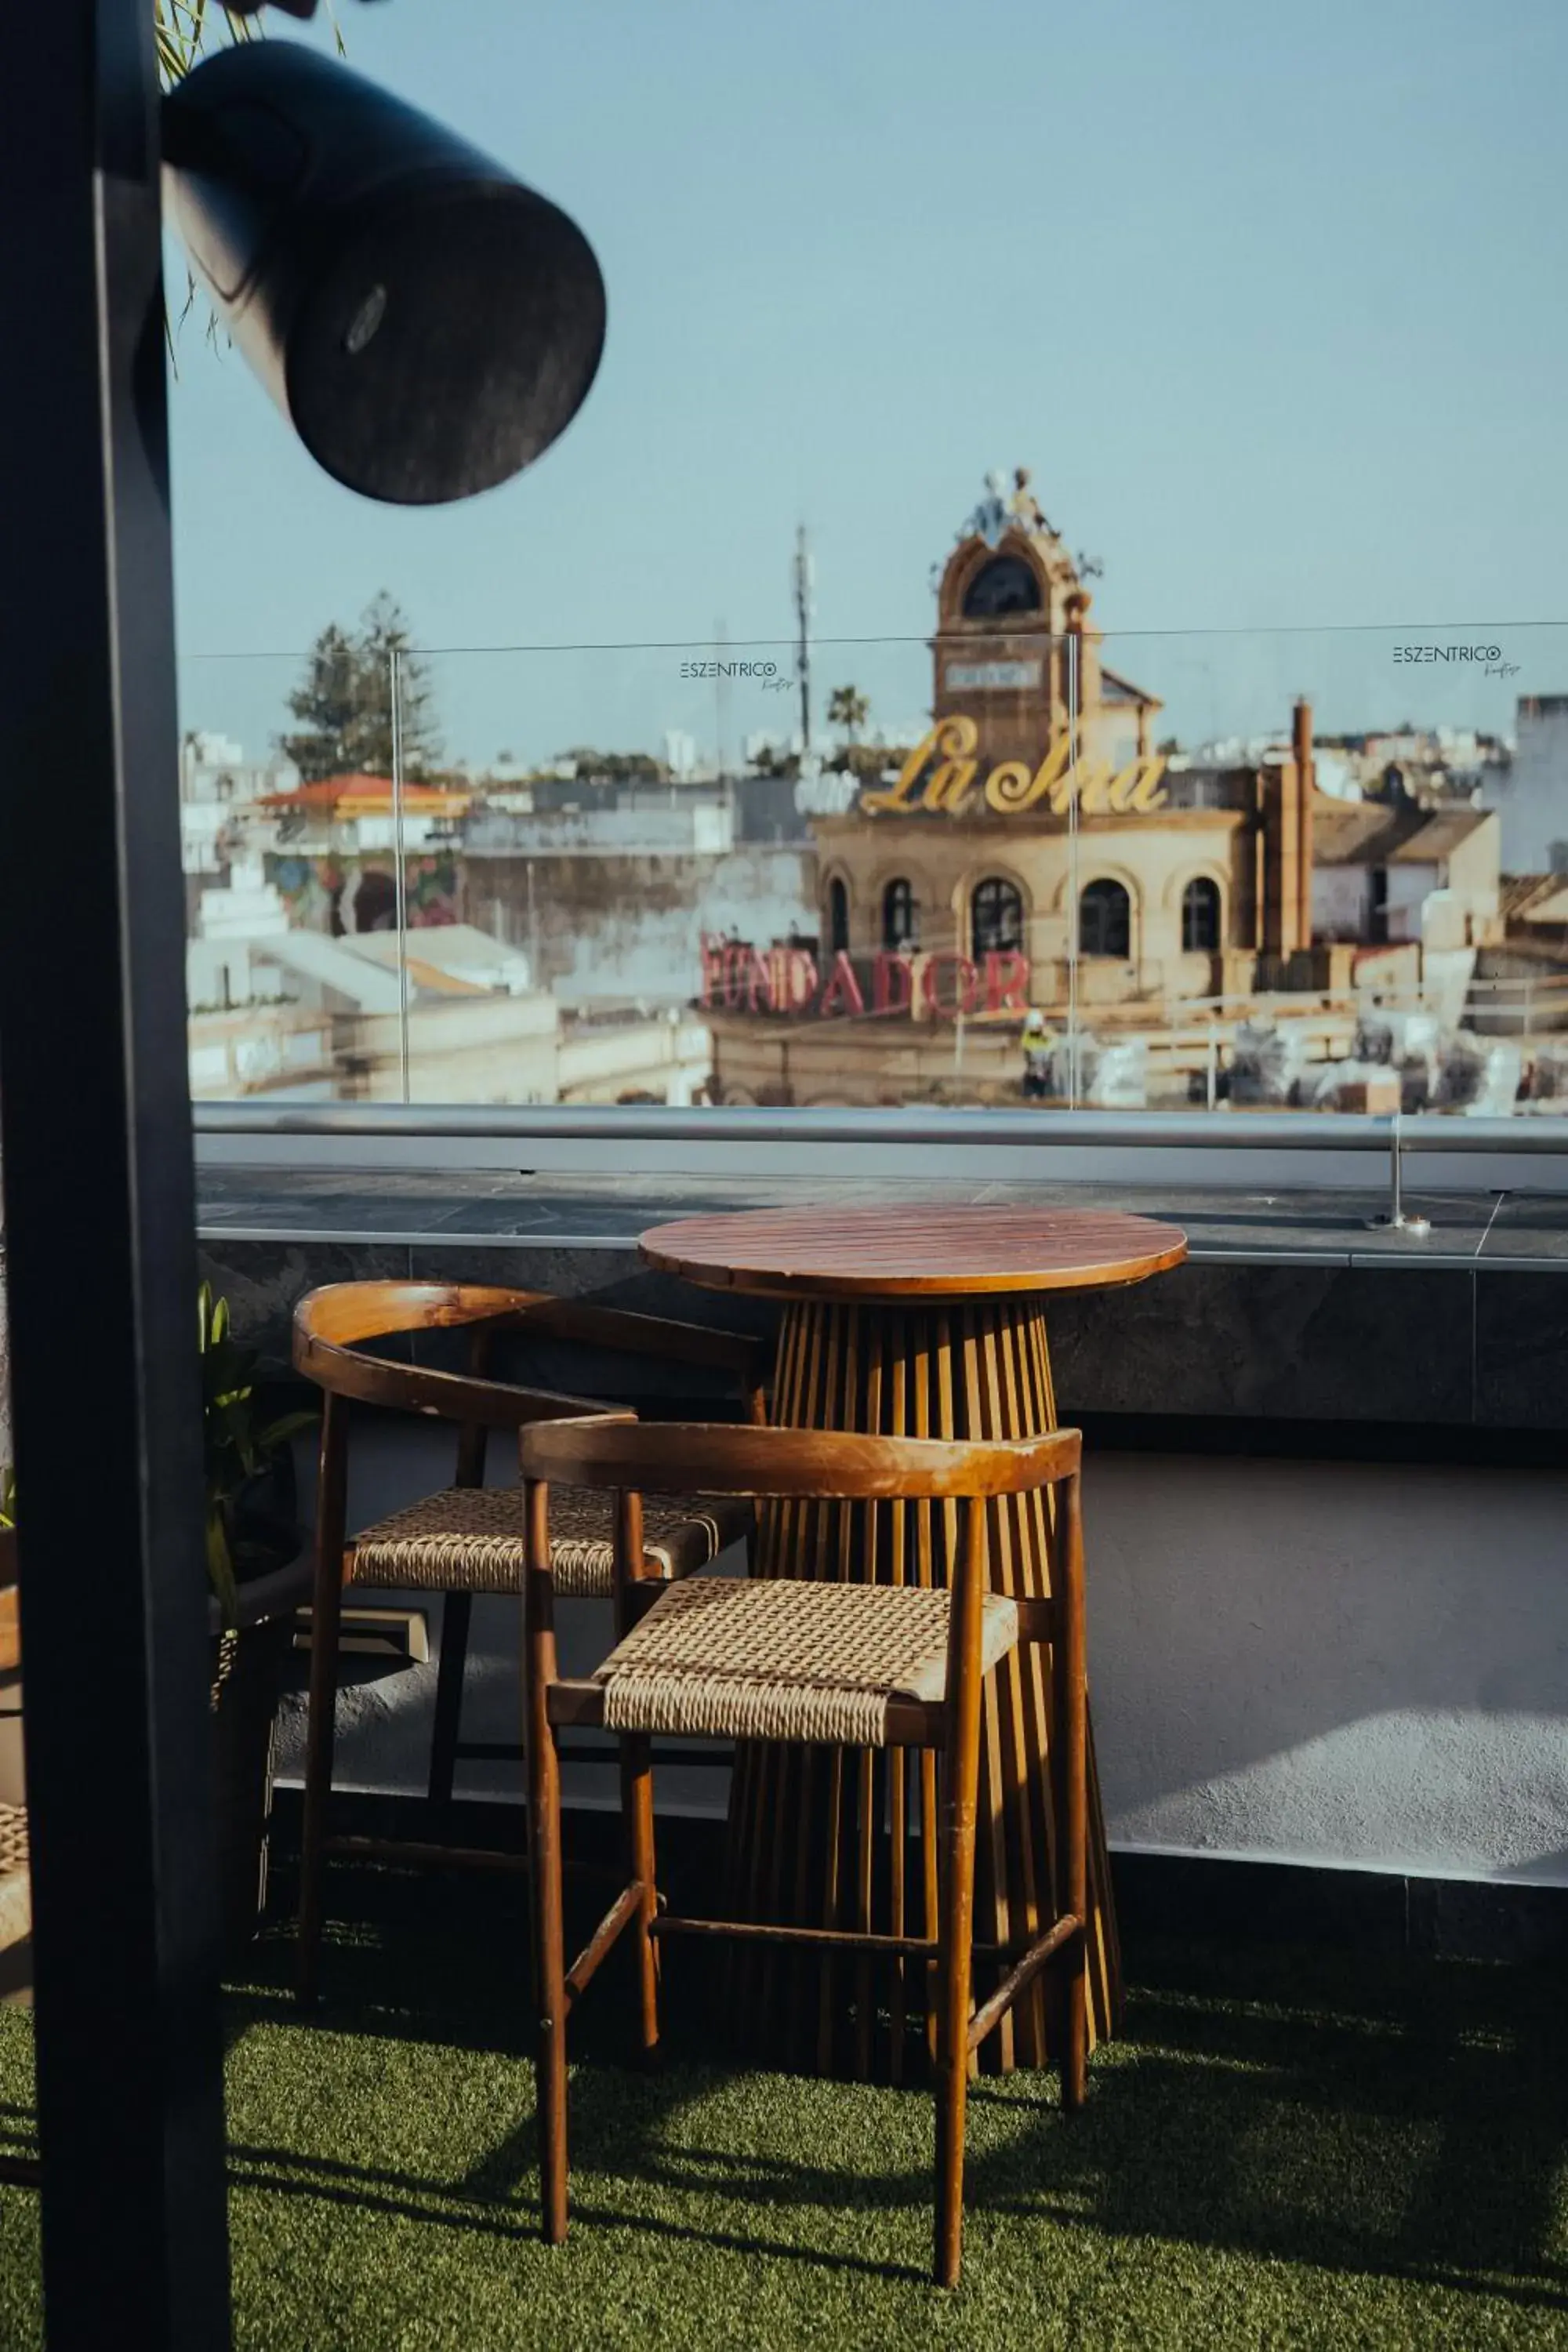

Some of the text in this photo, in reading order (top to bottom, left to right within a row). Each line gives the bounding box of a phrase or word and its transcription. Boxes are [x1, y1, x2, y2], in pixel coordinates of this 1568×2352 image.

[1392, 646, 1501, 662] ESZENTRICO
[681, 662, 777, 678] ESZENTRICO
[861, 715, 978, 813] La
